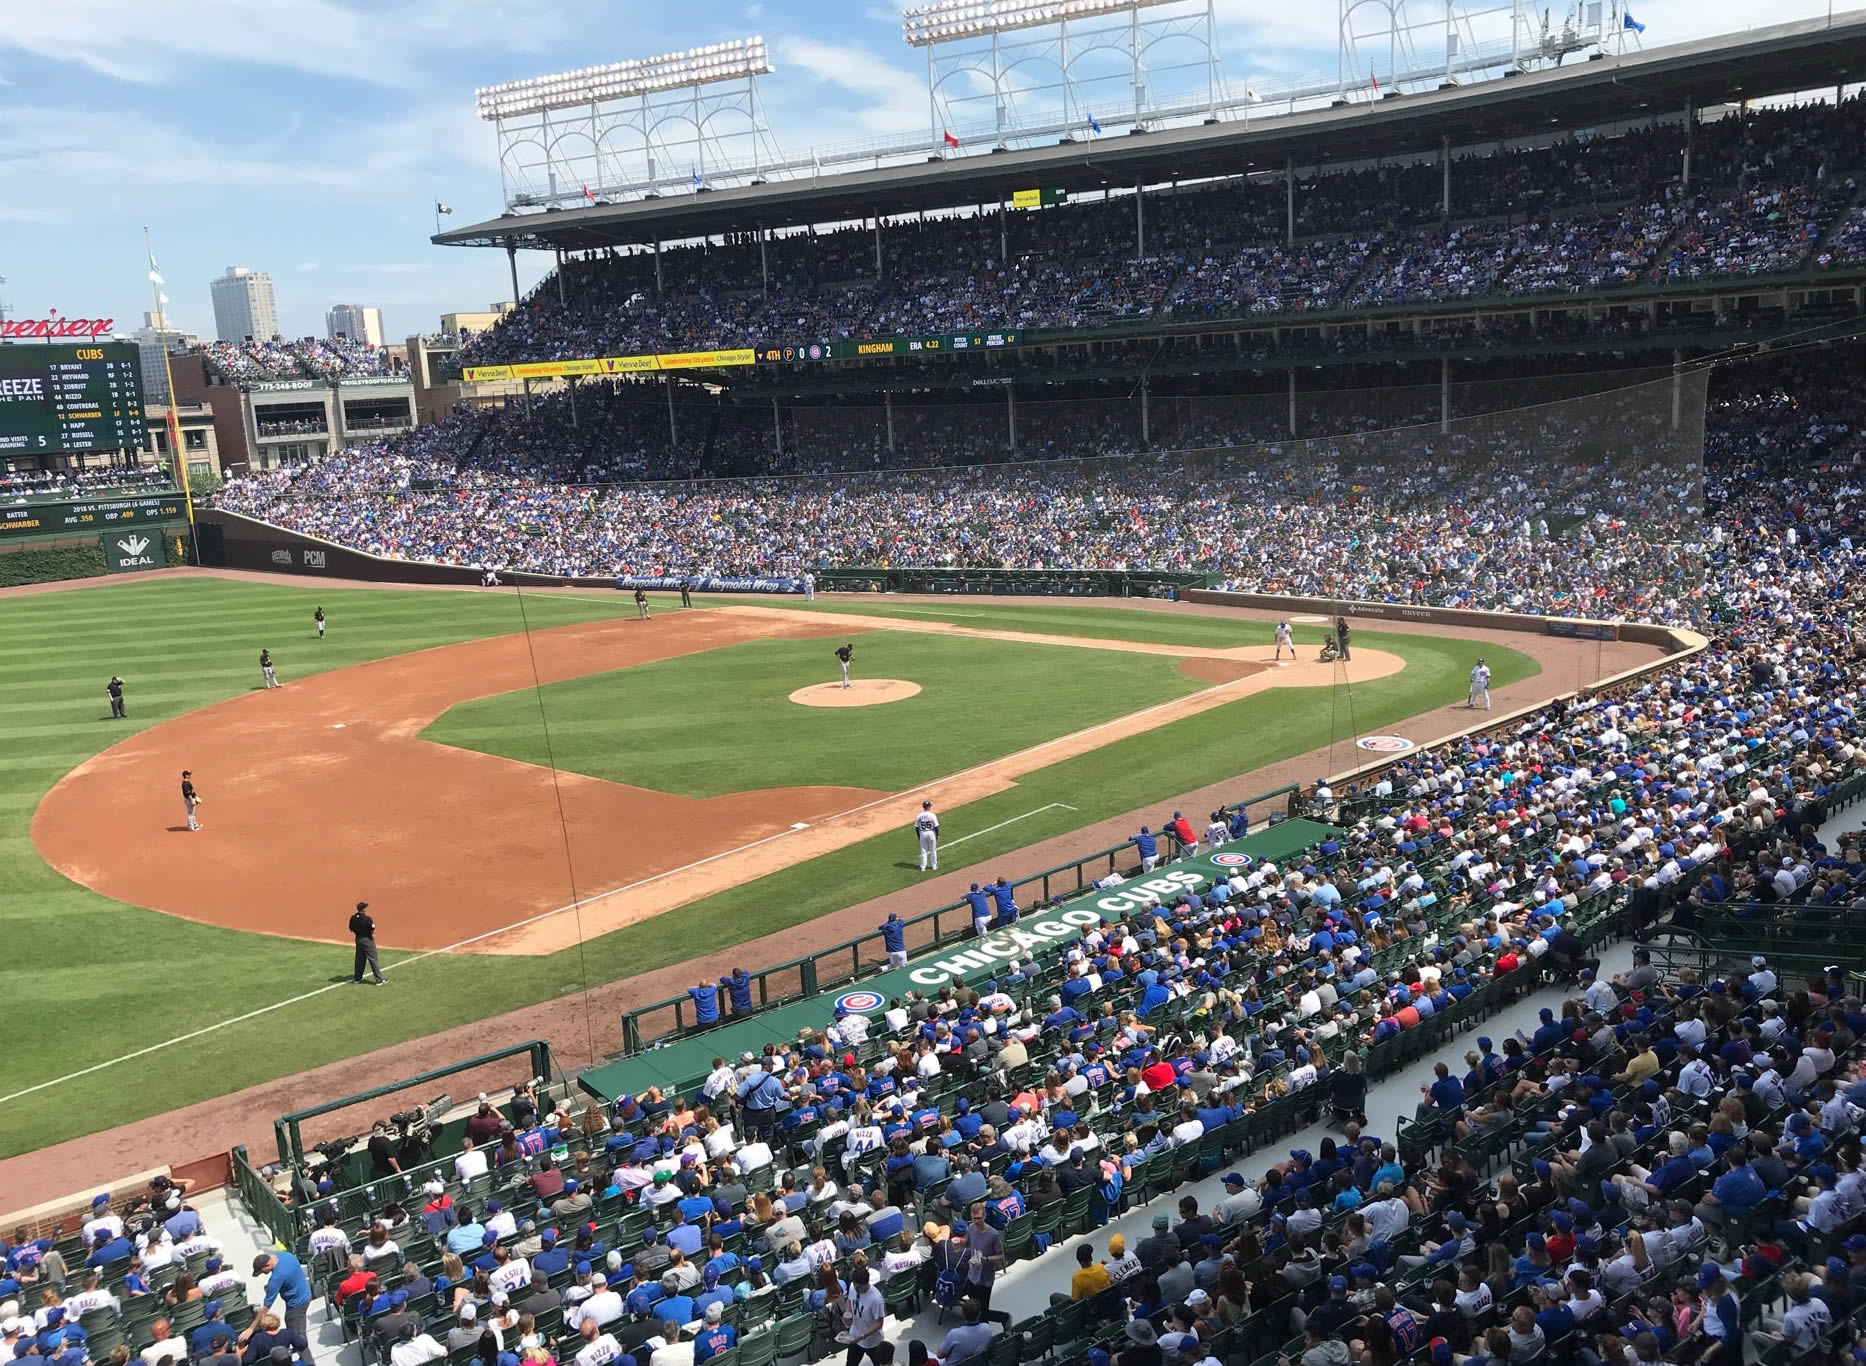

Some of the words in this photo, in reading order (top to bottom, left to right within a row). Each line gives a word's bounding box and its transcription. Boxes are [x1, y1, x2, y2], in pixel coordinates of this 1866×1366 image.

[77, 349, 104, 360] CUBS
[766, 350, 780, 360] 4TH
[799, 348, 805, 358] 0
[826, 346, 831, 357] 2
[858, 343, 893, 354] KINGHAM
[910, 342, 922, 350] ERA
[926, 341, 939, 349] 4.22
[638, 360, 652, 368] Beef
[38, 436, 46, 446] 5
[120, 556, 154, 566] IDEAL
[304, 550, 325, 565] PCM
[622, 577, 662, 589] Reynolds
[709, 578, 752, 591] Reynolds
[752, 580, 779, 592] Wrap
[921, 821, 931, 830] 55
[910, 910, 1101, 984] CHICAGO
[1097, 871, 1204, 911] CUBS
[1089, 1075, 1104, 1088] 17
[527, 1139, 543, 1155] 17
[855, 1140, 873, 1152] 44
[817, 1250, 833, 1265] 44
[499, 1267, 523, 1283] LESTER
[590, 1346, 611, 1362] RIZZO
